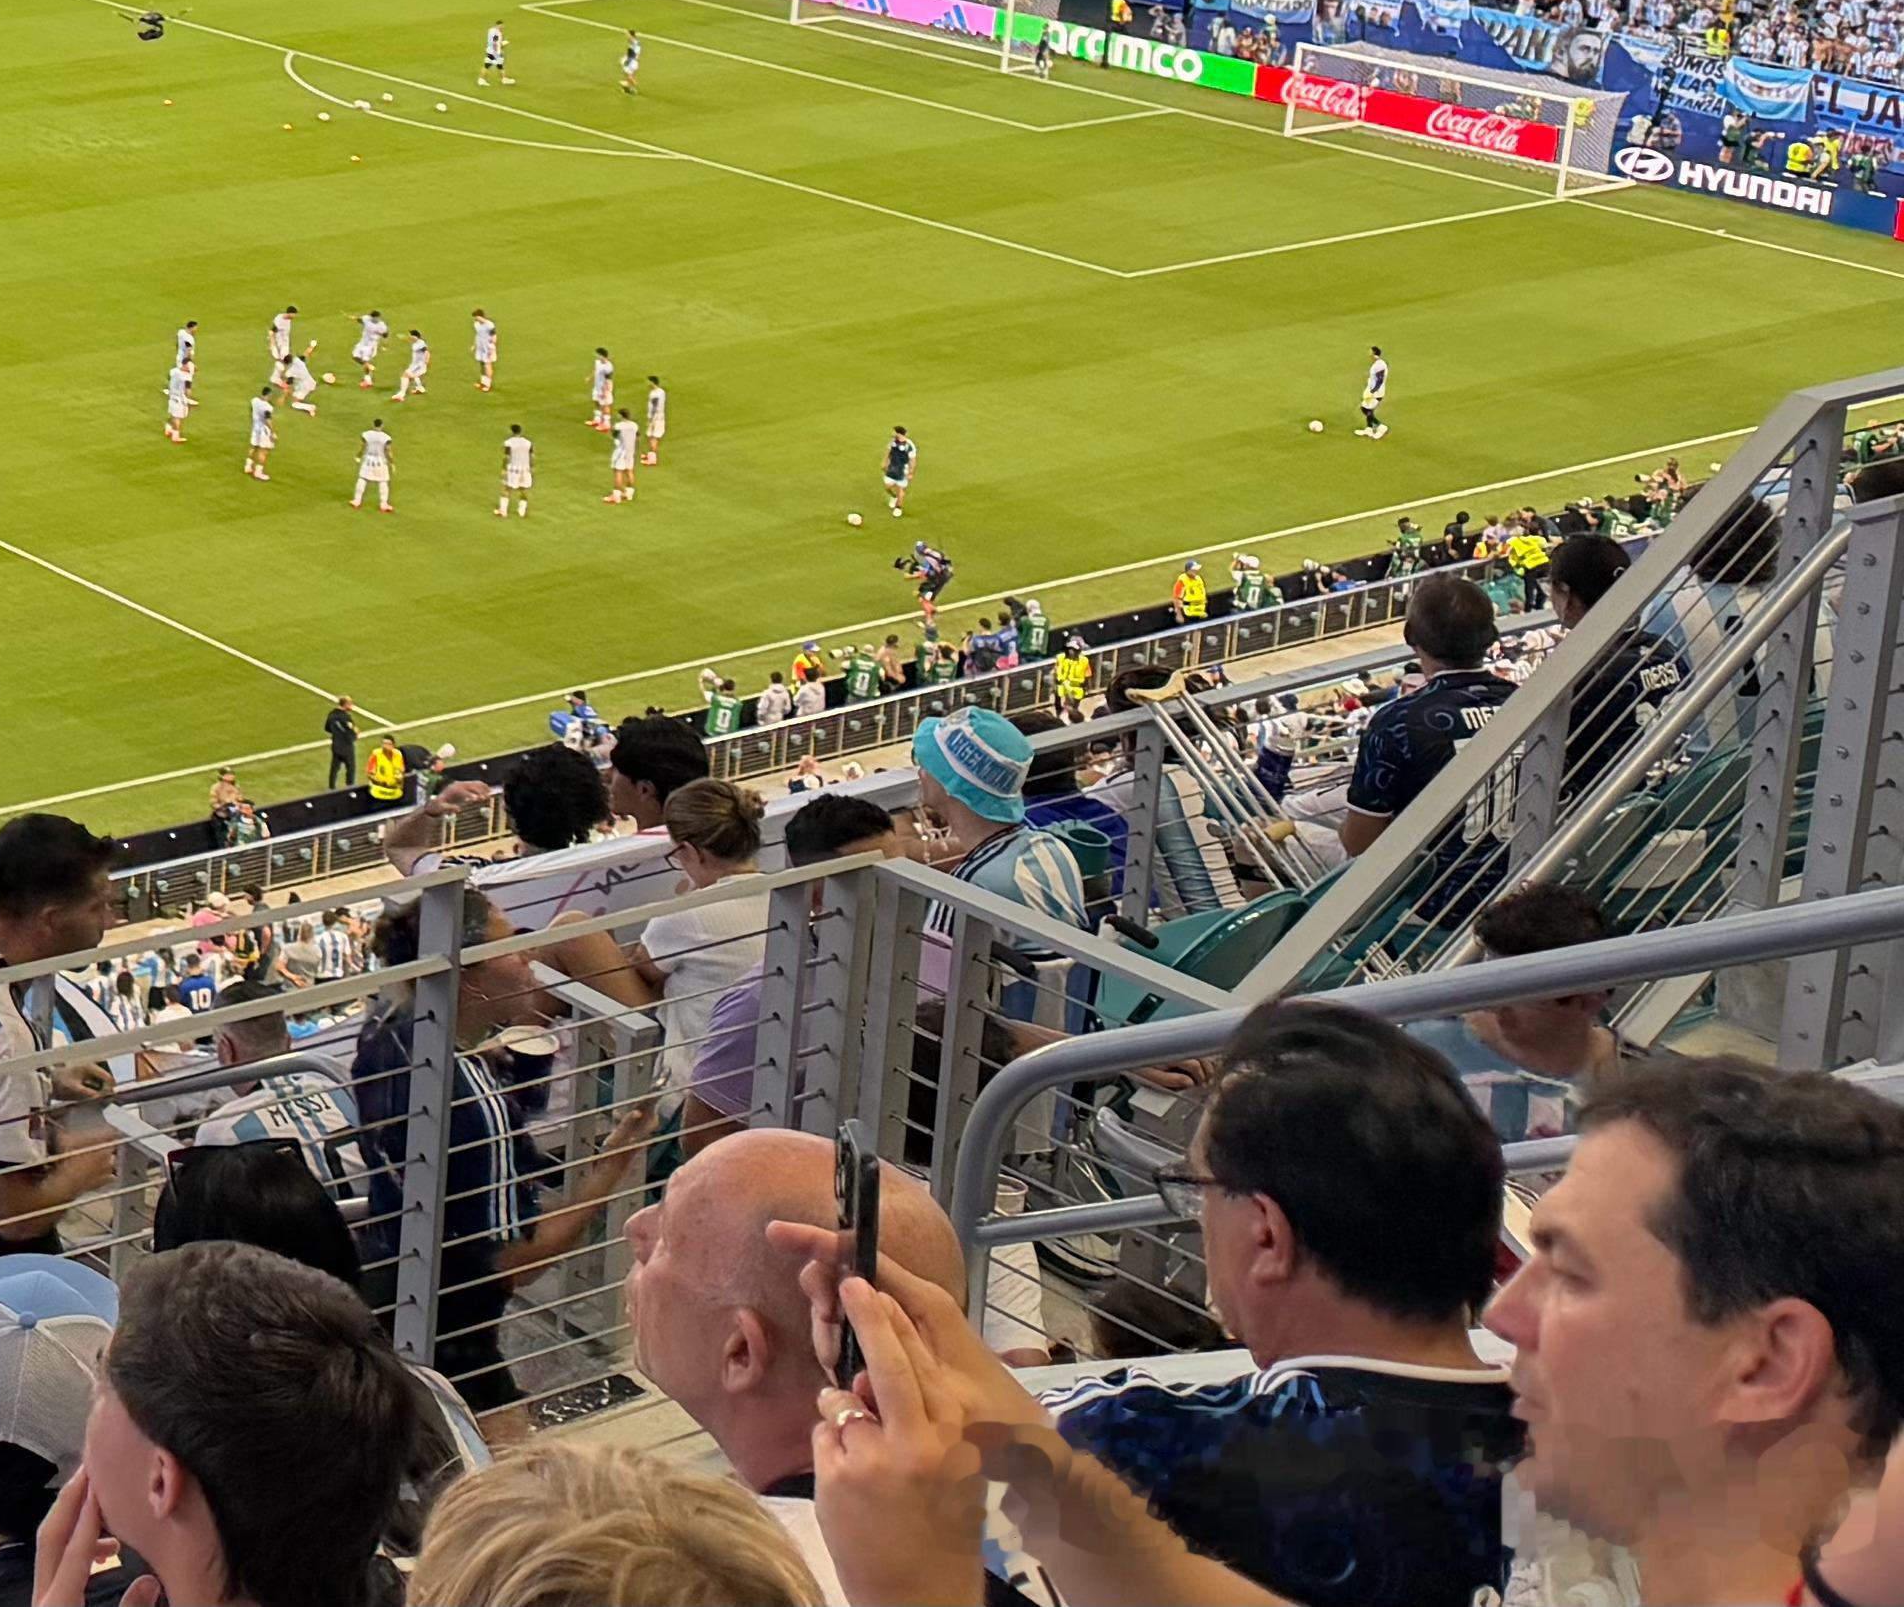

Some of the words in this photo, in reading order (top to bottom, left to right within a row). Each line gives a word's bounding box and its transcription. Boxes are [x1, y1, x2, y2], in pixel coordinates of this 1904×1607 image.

[1678, 160, 1833, 216] HYUNDAI
[1460, 705, 1501, 730] ME
[190, 988, 211, 1010] 10
